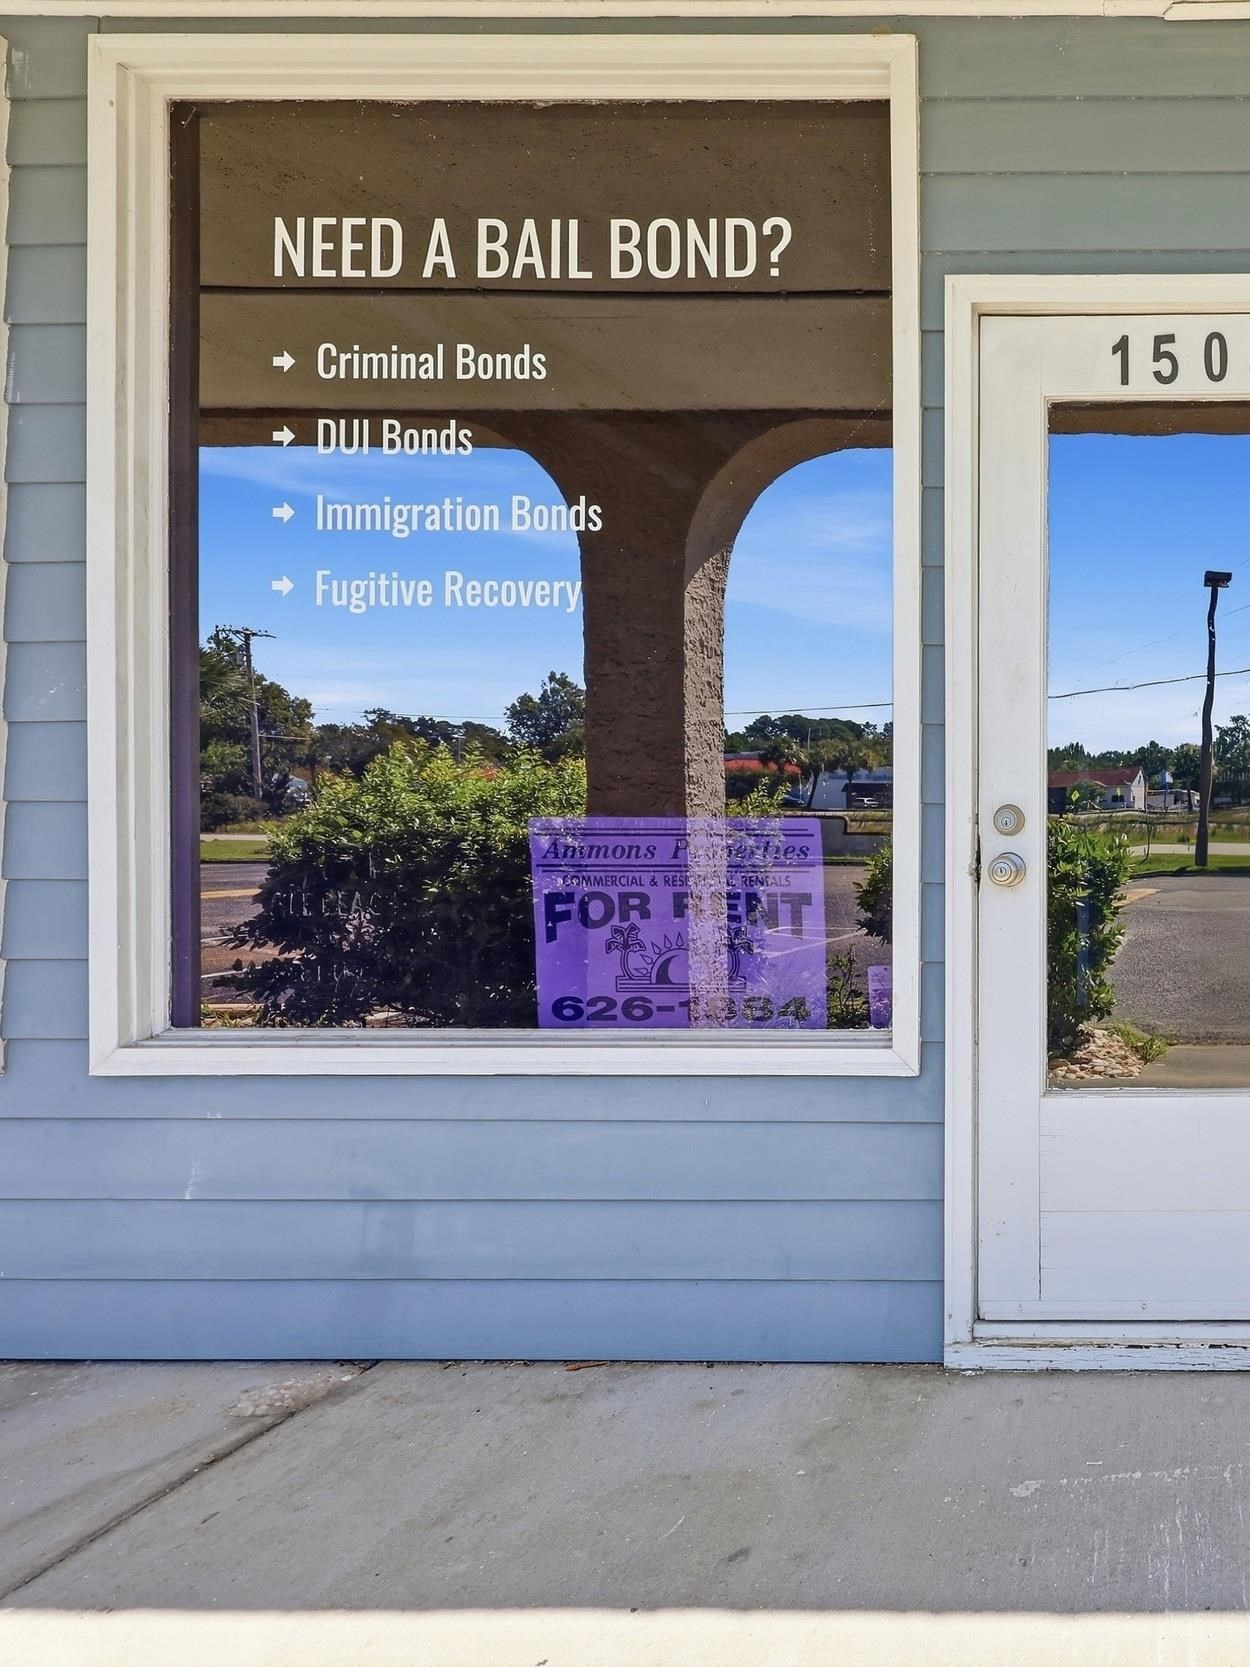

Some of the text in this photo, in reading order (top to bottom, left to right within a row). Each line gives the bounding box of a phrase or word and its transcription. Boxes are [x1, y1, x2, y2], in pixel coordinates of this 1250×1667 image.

[273, 216, 793, 279] NEED A BAIL BOND?
[316, 343, 547, 381] Criminal Bonds
[316, 419, 474, 456] DUI Bonds
[315, 495, 603, 538] Immigration Bonds
[315, 570, 583, 614] Fugitive Recovery
[541, 838, 811, 861] Ammons Pperties
[563, 875, 791, 888] COMMERCIAL & RESIAL RENTALS
[544, 891, 812, 944] FOR RENT
[551, 996, 812, 1022] 626-184
